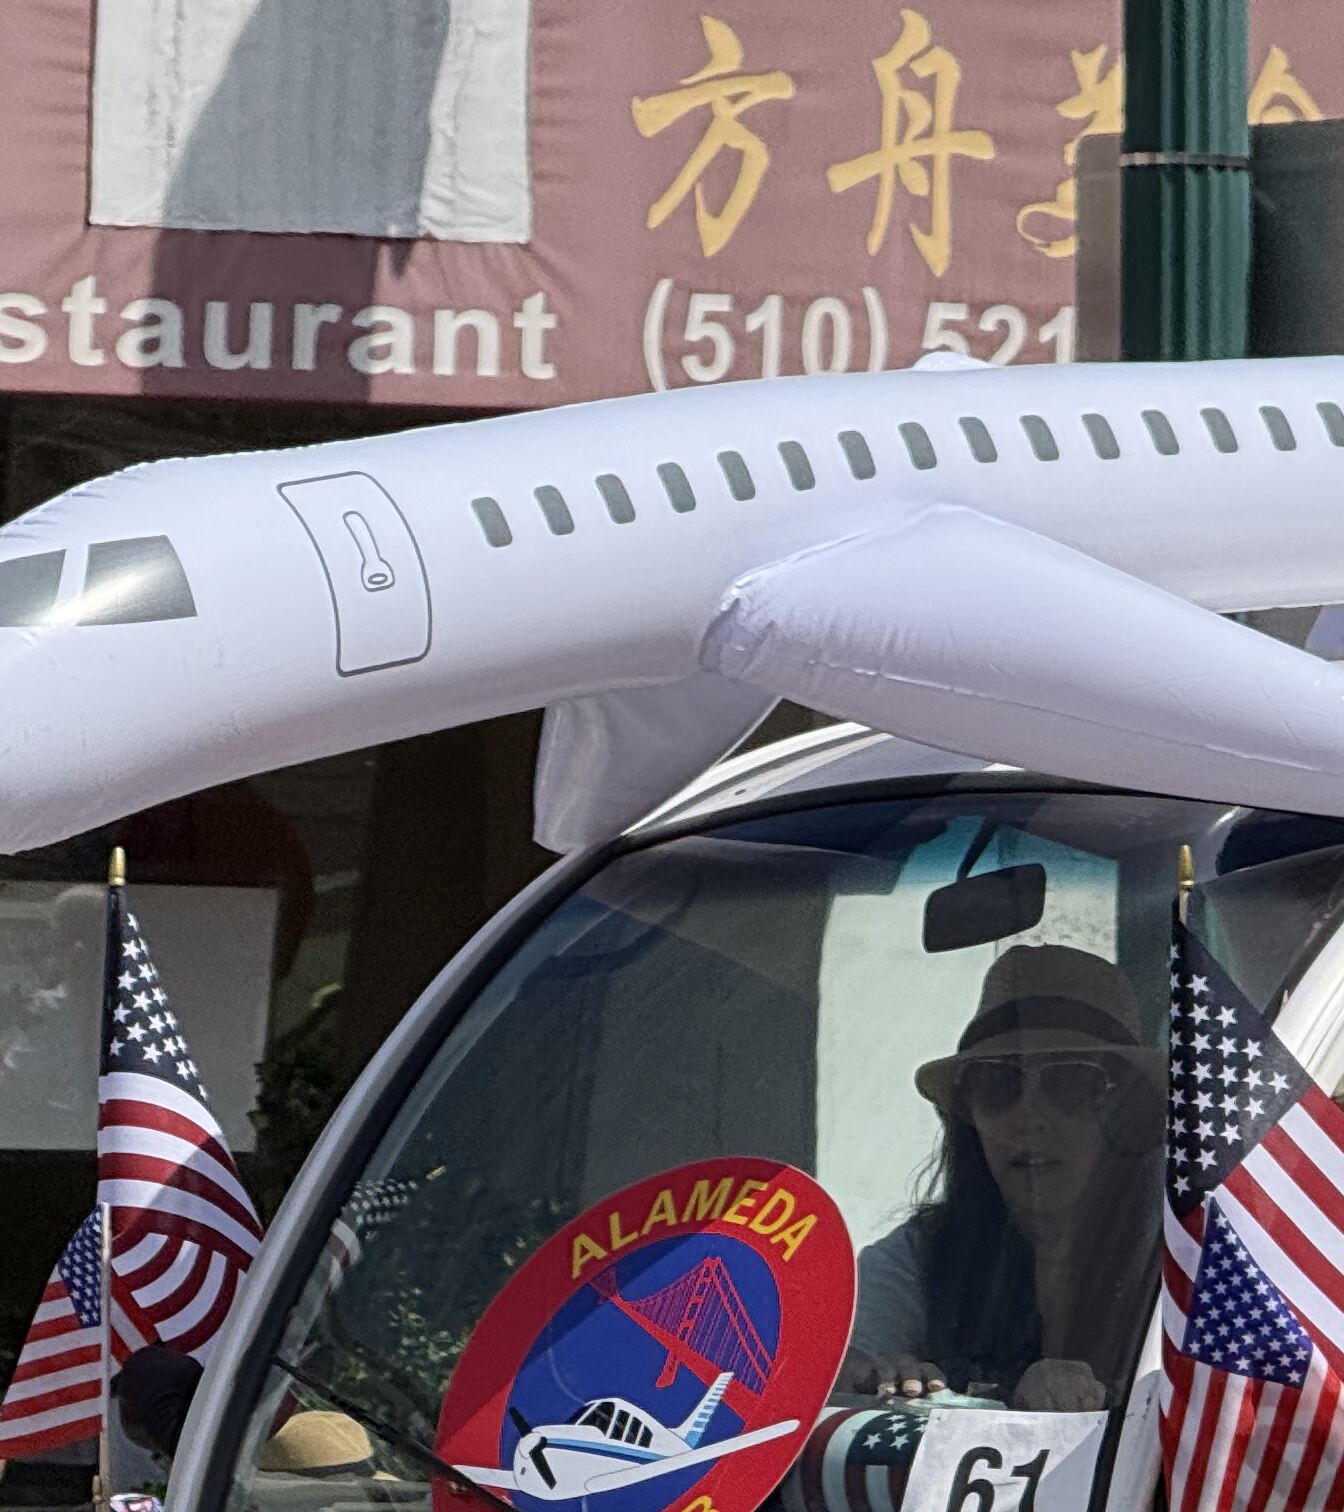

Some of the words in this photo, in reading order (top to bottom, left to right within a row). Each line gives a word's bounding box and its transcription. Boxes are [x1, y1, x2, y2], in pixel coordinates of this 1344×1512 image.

[631, 7, 1323, 278] 方舟
[642, 278, 889, 393] (510)
[570, 1177, 818, 1280] ALAMEDA
